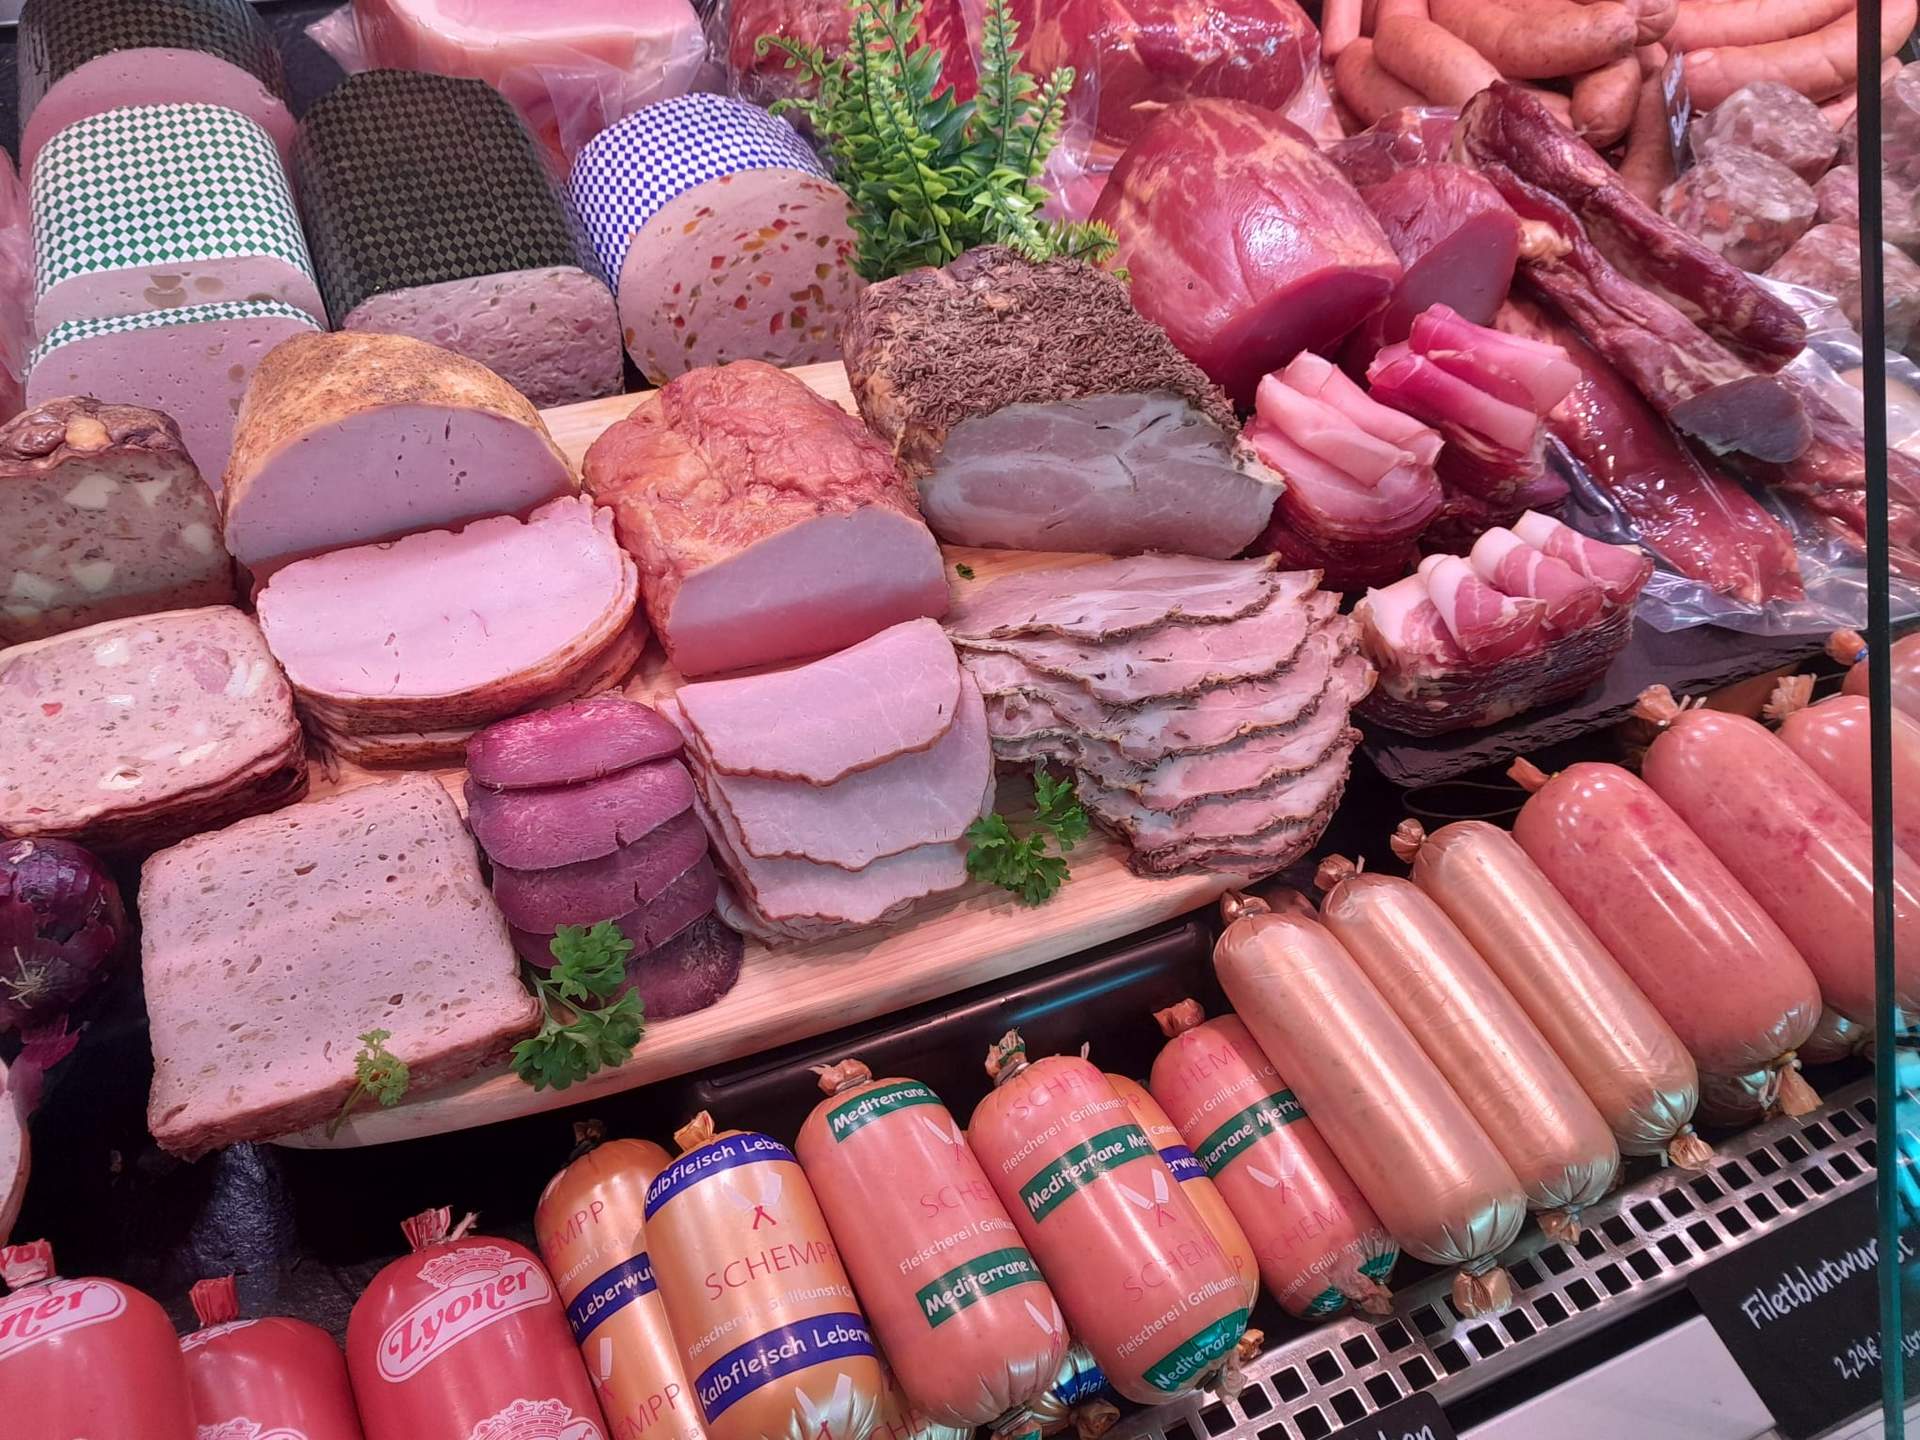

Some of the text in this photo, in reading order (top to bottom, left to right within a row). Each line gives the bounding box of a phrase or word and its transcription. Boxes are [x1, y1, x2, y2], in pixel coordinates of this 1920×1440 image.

[833, 1087, 928, 1133] Mediterrane
[1002, 1121, 1061, 1174] Fleischerei
[1027, 1141, 1126, 1213] Mediterrane
[899, 1226, 973, 1275] Fleischerei
[388, 1265, 534, 1364] Lyoner
[925, 1258, 1030, 1317] Mediterrane
[1116, 1306, 1181, 1359] Fleischerei
[699, 1336, 807, 1410] Kalbfleisch
